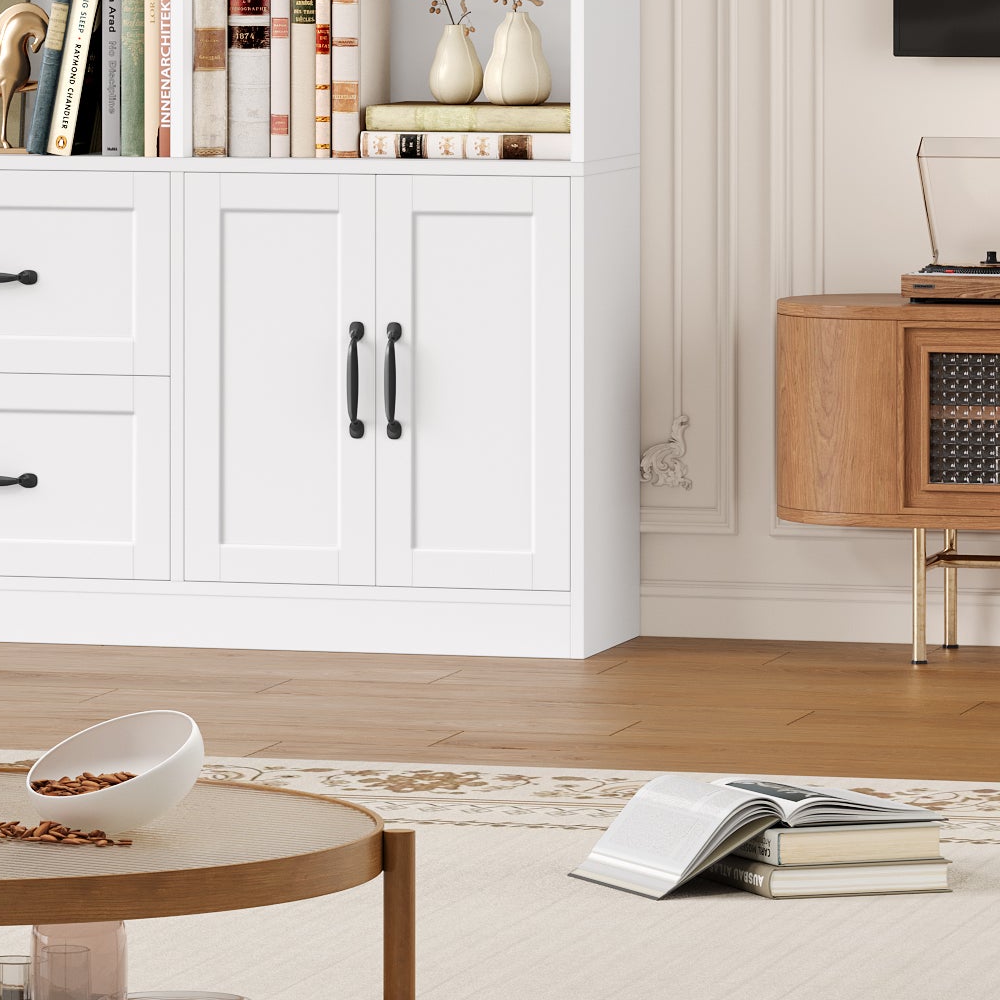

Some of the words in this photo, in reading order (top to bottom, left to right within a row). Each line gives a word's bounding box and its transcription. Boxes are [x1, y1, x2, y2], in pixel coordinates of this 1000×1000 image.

[78, 11, 88, 34] SLEEP
[108, 6, 117, 33] Arad
[69, 43, 82, 85] RAYMOND
[61, 87, 74, 129] CHANDLER
[733, 868, 765, 888] AUSBAU
